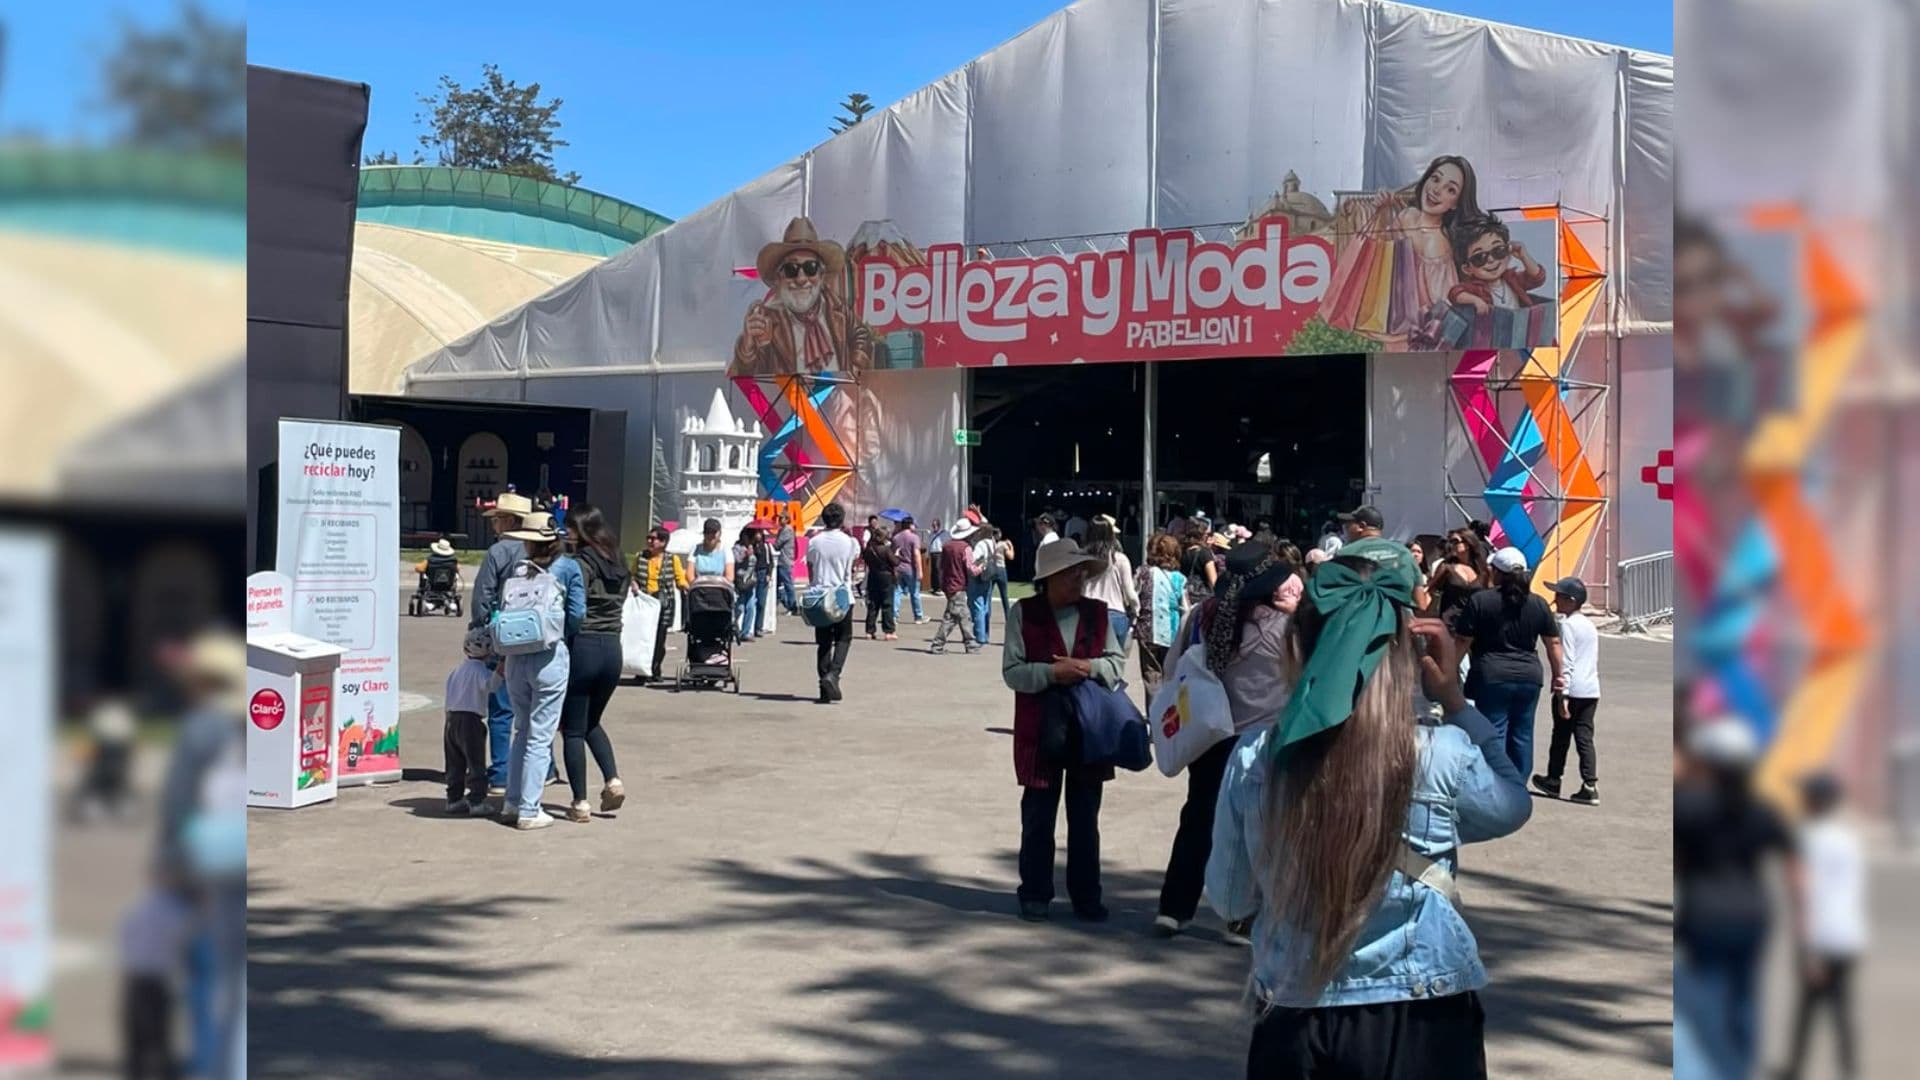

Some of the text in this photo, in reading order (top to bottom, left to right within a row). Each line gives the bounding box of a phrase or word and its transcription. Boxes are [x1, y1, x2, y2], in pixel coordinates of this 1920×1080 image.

[862, 223, 1331, 342] Belleza y Moda
[1243, 315, 1252, 343] 1
[304, 443, 376, 461] ¿Qué puedes
[304, 463, 376, 482] reciclar hoy?
[342, 680, 389, 696] soy Claro
[251, 704, 279, 715] Claro
